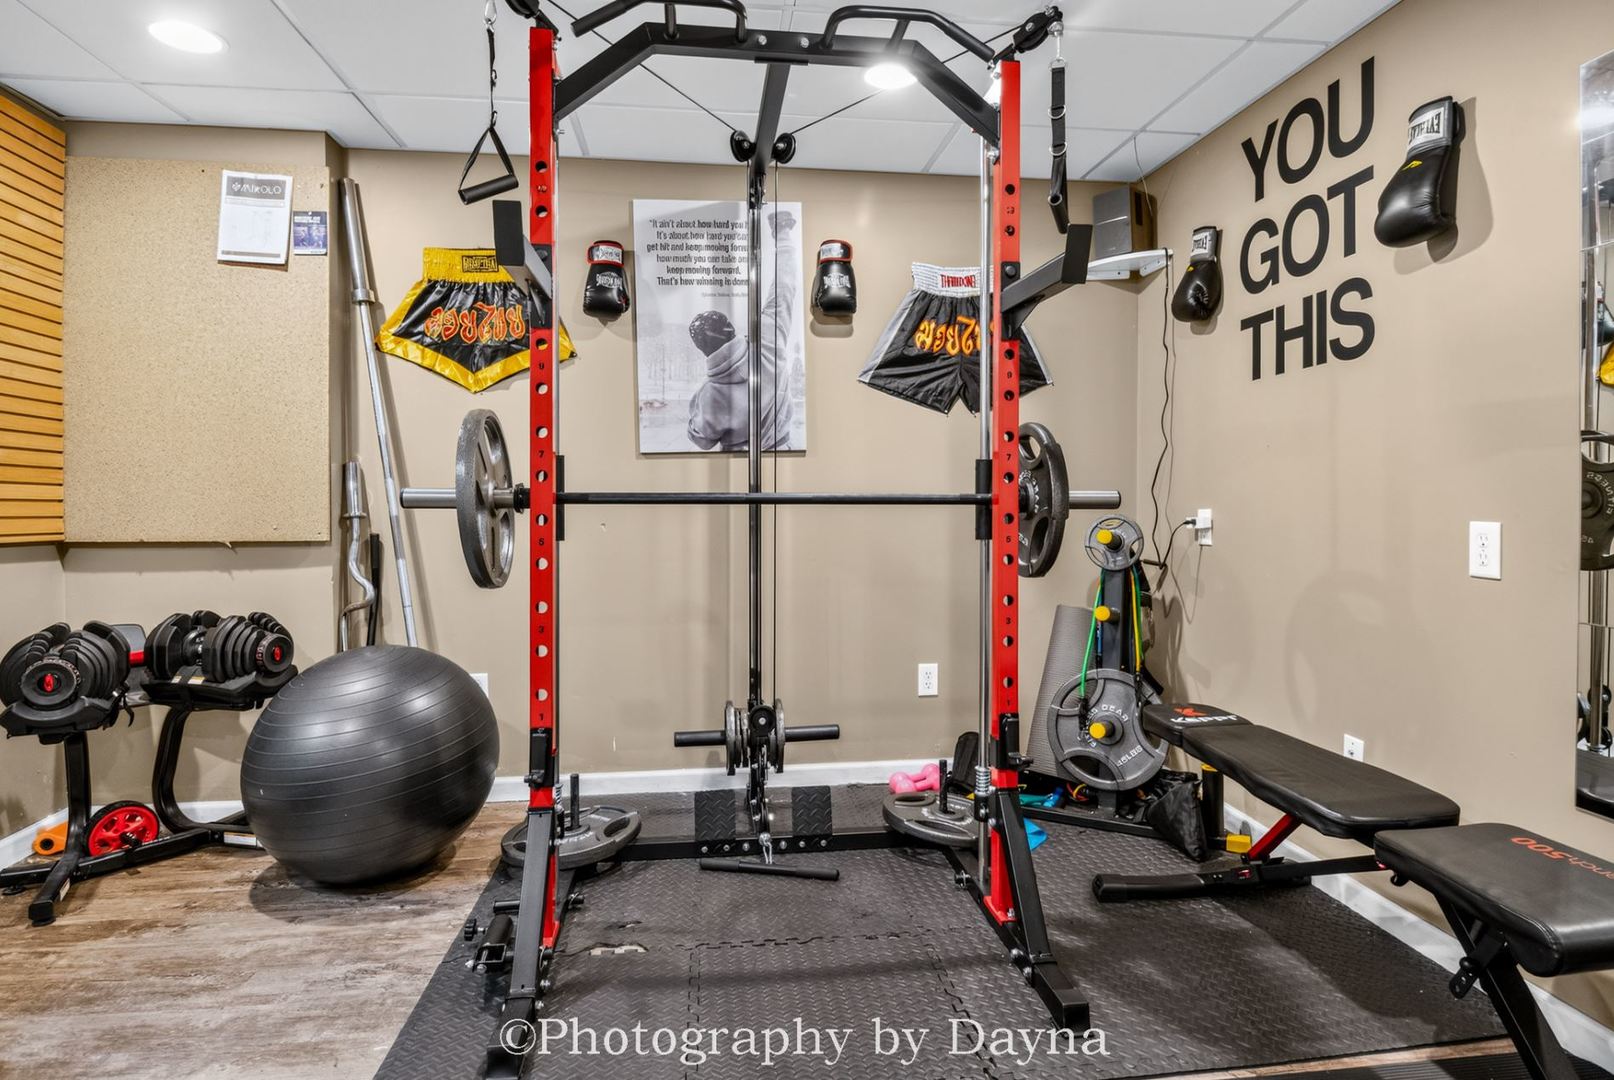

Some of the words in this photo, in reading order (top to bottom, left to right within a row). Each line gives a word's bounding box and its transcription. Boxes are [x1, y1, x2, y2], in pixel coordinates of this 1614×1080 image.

[1241, 56, 1375, 203] YOU
[698, 220, 711, 228] how
[714, 220, 729, 228] hard
[731, 221, 744, 230] you
[1240, 164, 1374, 295] GOT
[647, 244, 658, 253] get
[660, 243, 670, 251] hit
[705, 244, 729, 252] moving
[657, 255, 672, 263] how
[672, 255, 692, 263] much
[693, 256, 707, 264] you
[722, 255, 736, 263] take
[667, 265, 684, 276] keep
[685, 266, 711, 276] moving
[657, 277, 678, 286] That's
[680, 277, 694, 286] how
[695, 278, 723, 287] winning
[1240, 277, 1375, 381] THIS
[915, 315, 995, 356] มวยไ
[538, 450, 544, 458] 7
[1006, 453, 1012, 461] 7
[538, 538, 545, 546] 5
[1006, 535, 1012, 543] 5
[1006, 617, 1012, 625] 3
[538, 626, 545, 634] 3
[1101, 704, 1129, 722] GEAR
